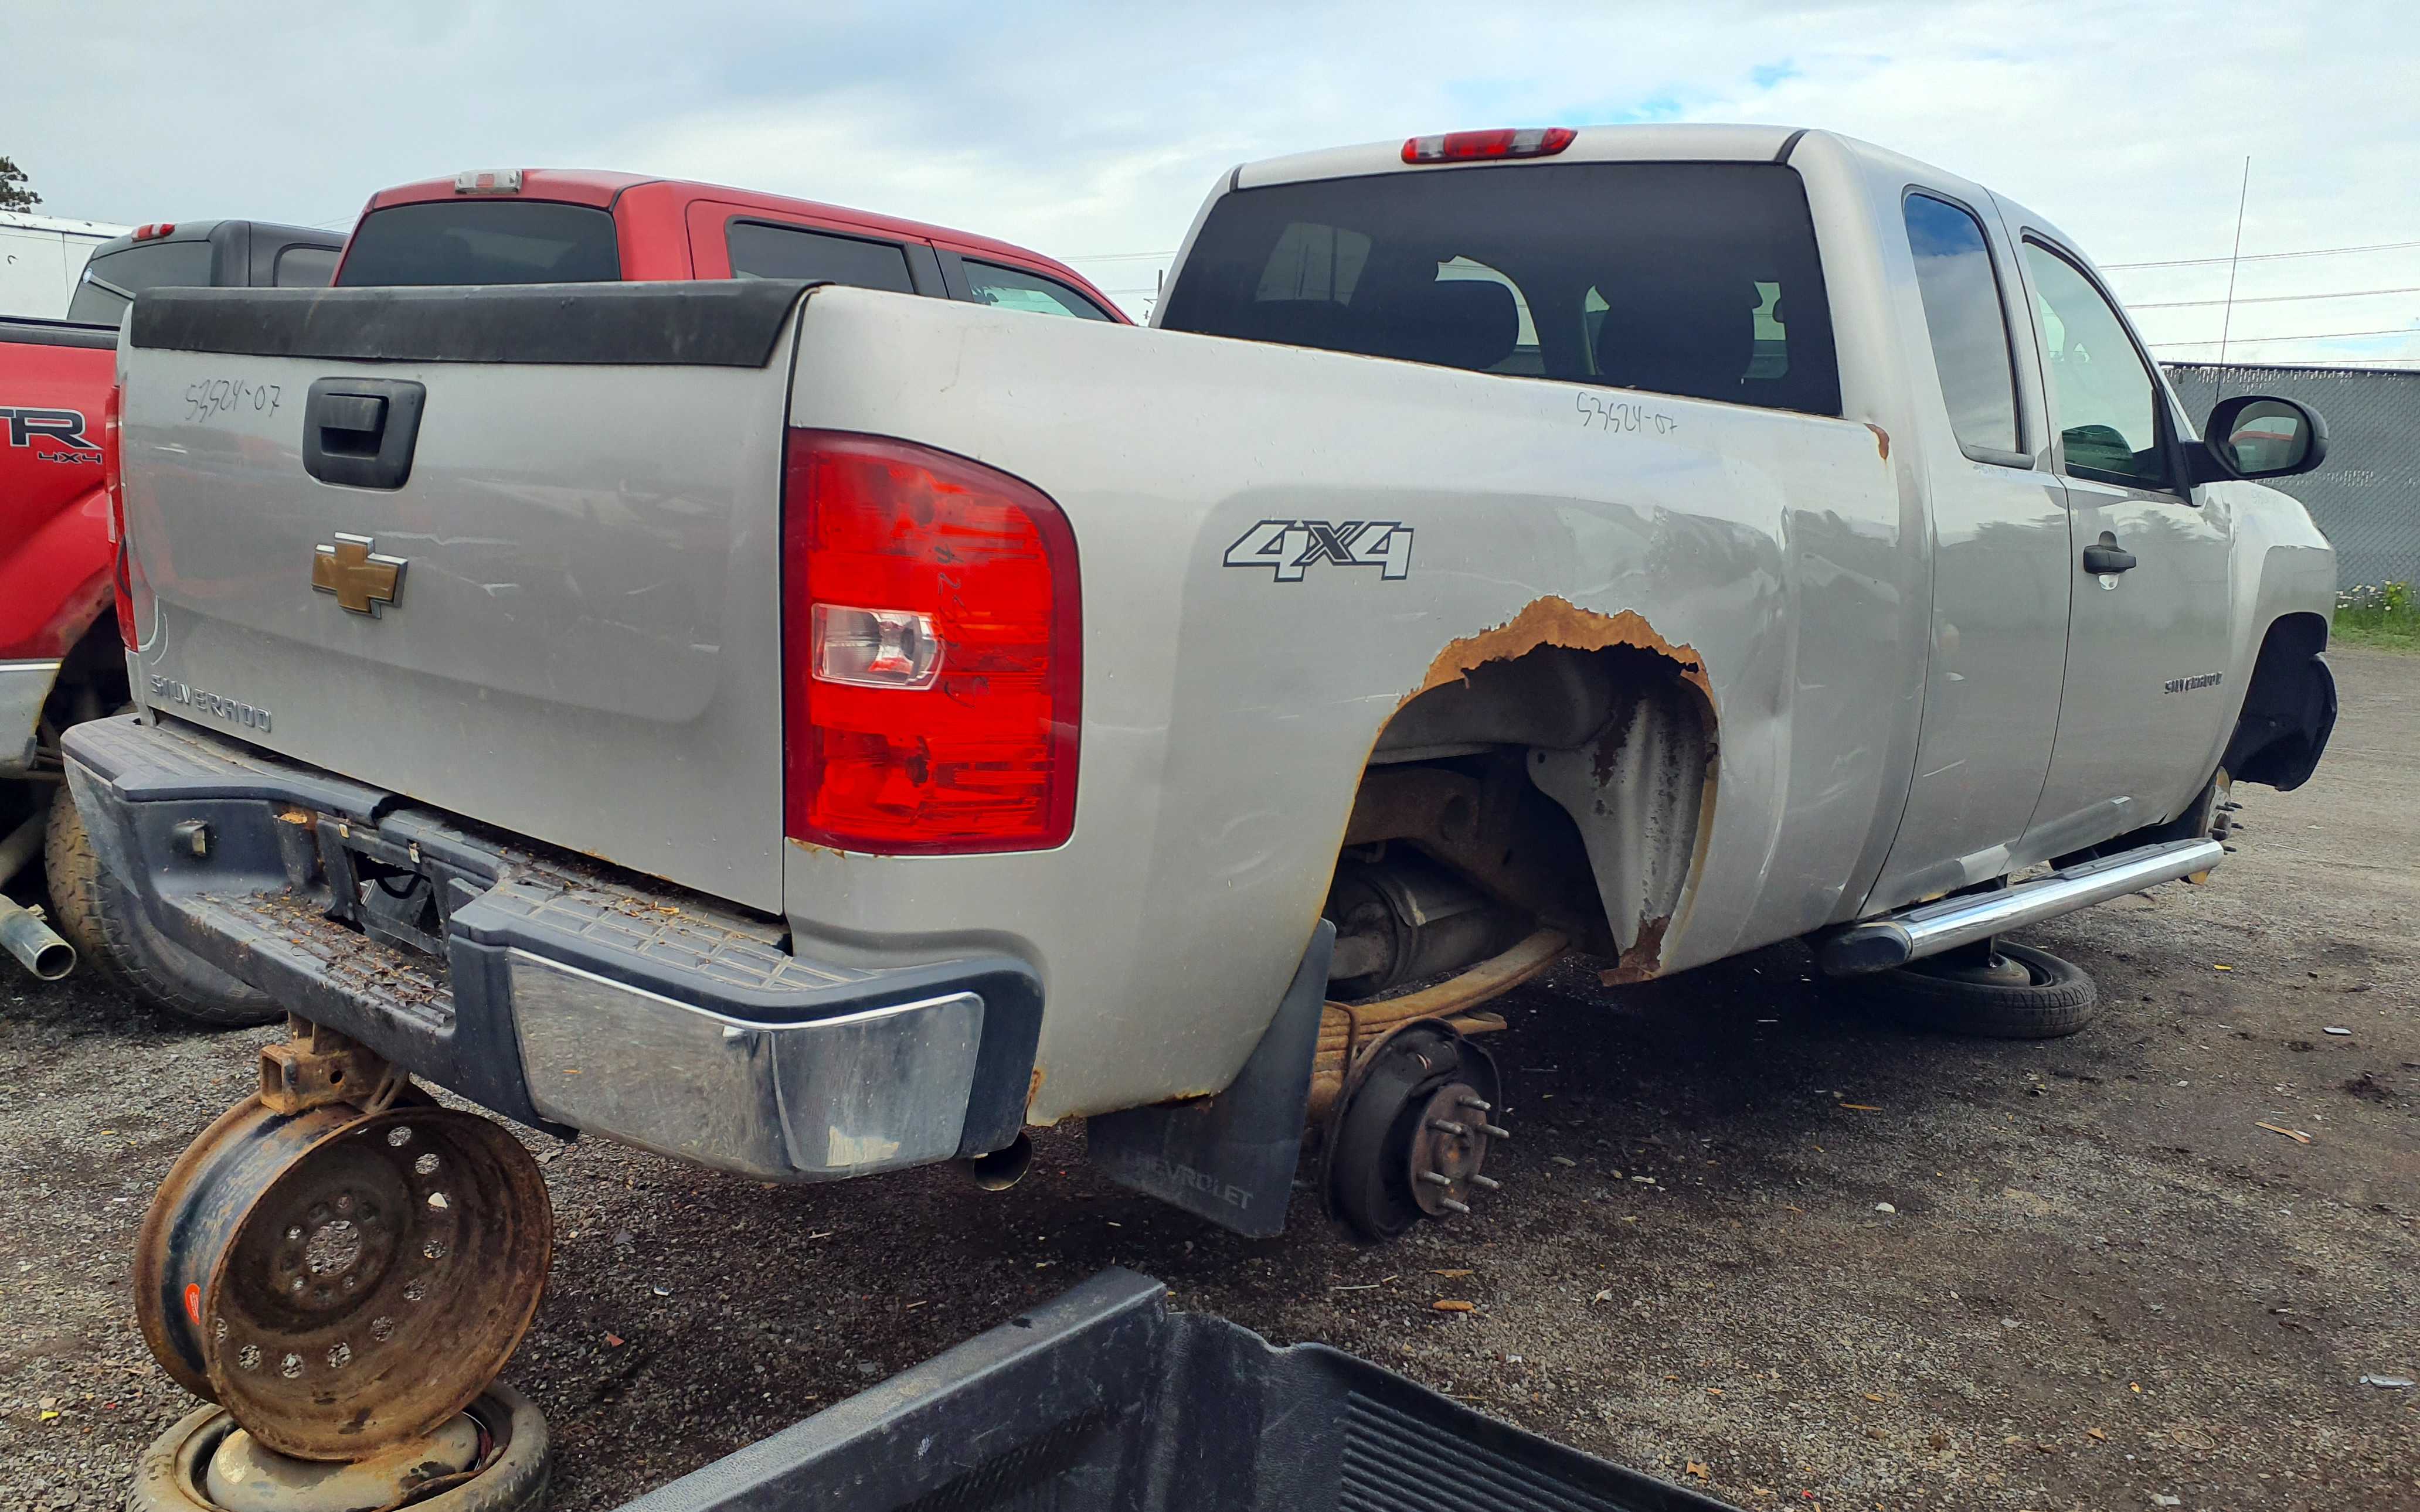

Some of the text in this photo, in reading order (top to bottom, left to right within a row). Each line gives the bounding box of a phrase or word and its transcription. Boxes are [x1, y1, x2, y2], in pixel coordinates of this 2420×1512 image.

[0, 406, 104, 451] R
[1576, 391, 1678, 434] 53524-07
[150, 674, 272, 733] SILVERADO
